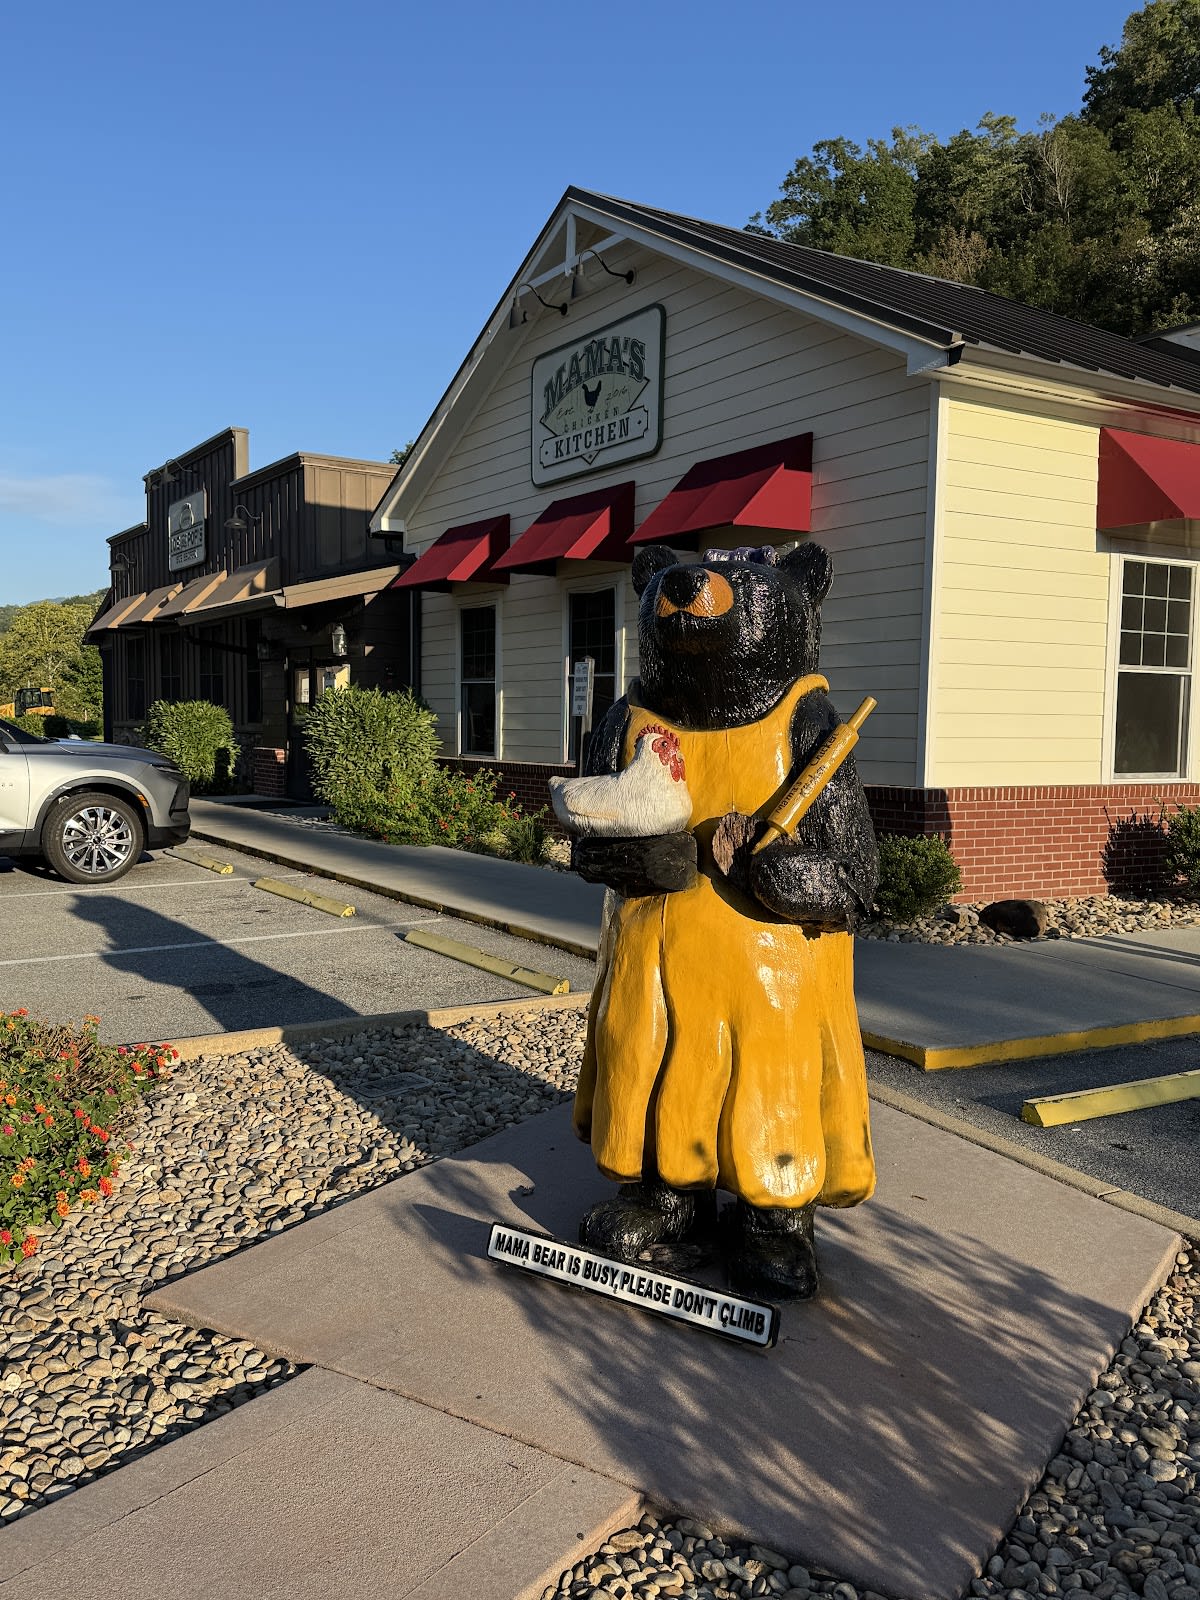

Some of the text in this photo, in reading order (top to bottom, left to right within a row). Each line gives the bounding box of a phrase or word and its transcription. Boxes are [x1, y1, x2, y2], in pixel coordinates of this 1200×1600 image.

[543, 336, 646, 416] MAMA'S
[555, 417, 630, 458] KITCHEN
[563, 407, 620, 433] CHICKEN
[495, 1232, 530, 1260] MAMA
[532, 1244, 566, 1271] BEAR
[567, 1255, 581, 1275] IS
[620, 1271, 672, 1305] PLEASE
[673, 1288, 718, 1319] DON'T
[719, 1302, 766, 1336] CLIMB
